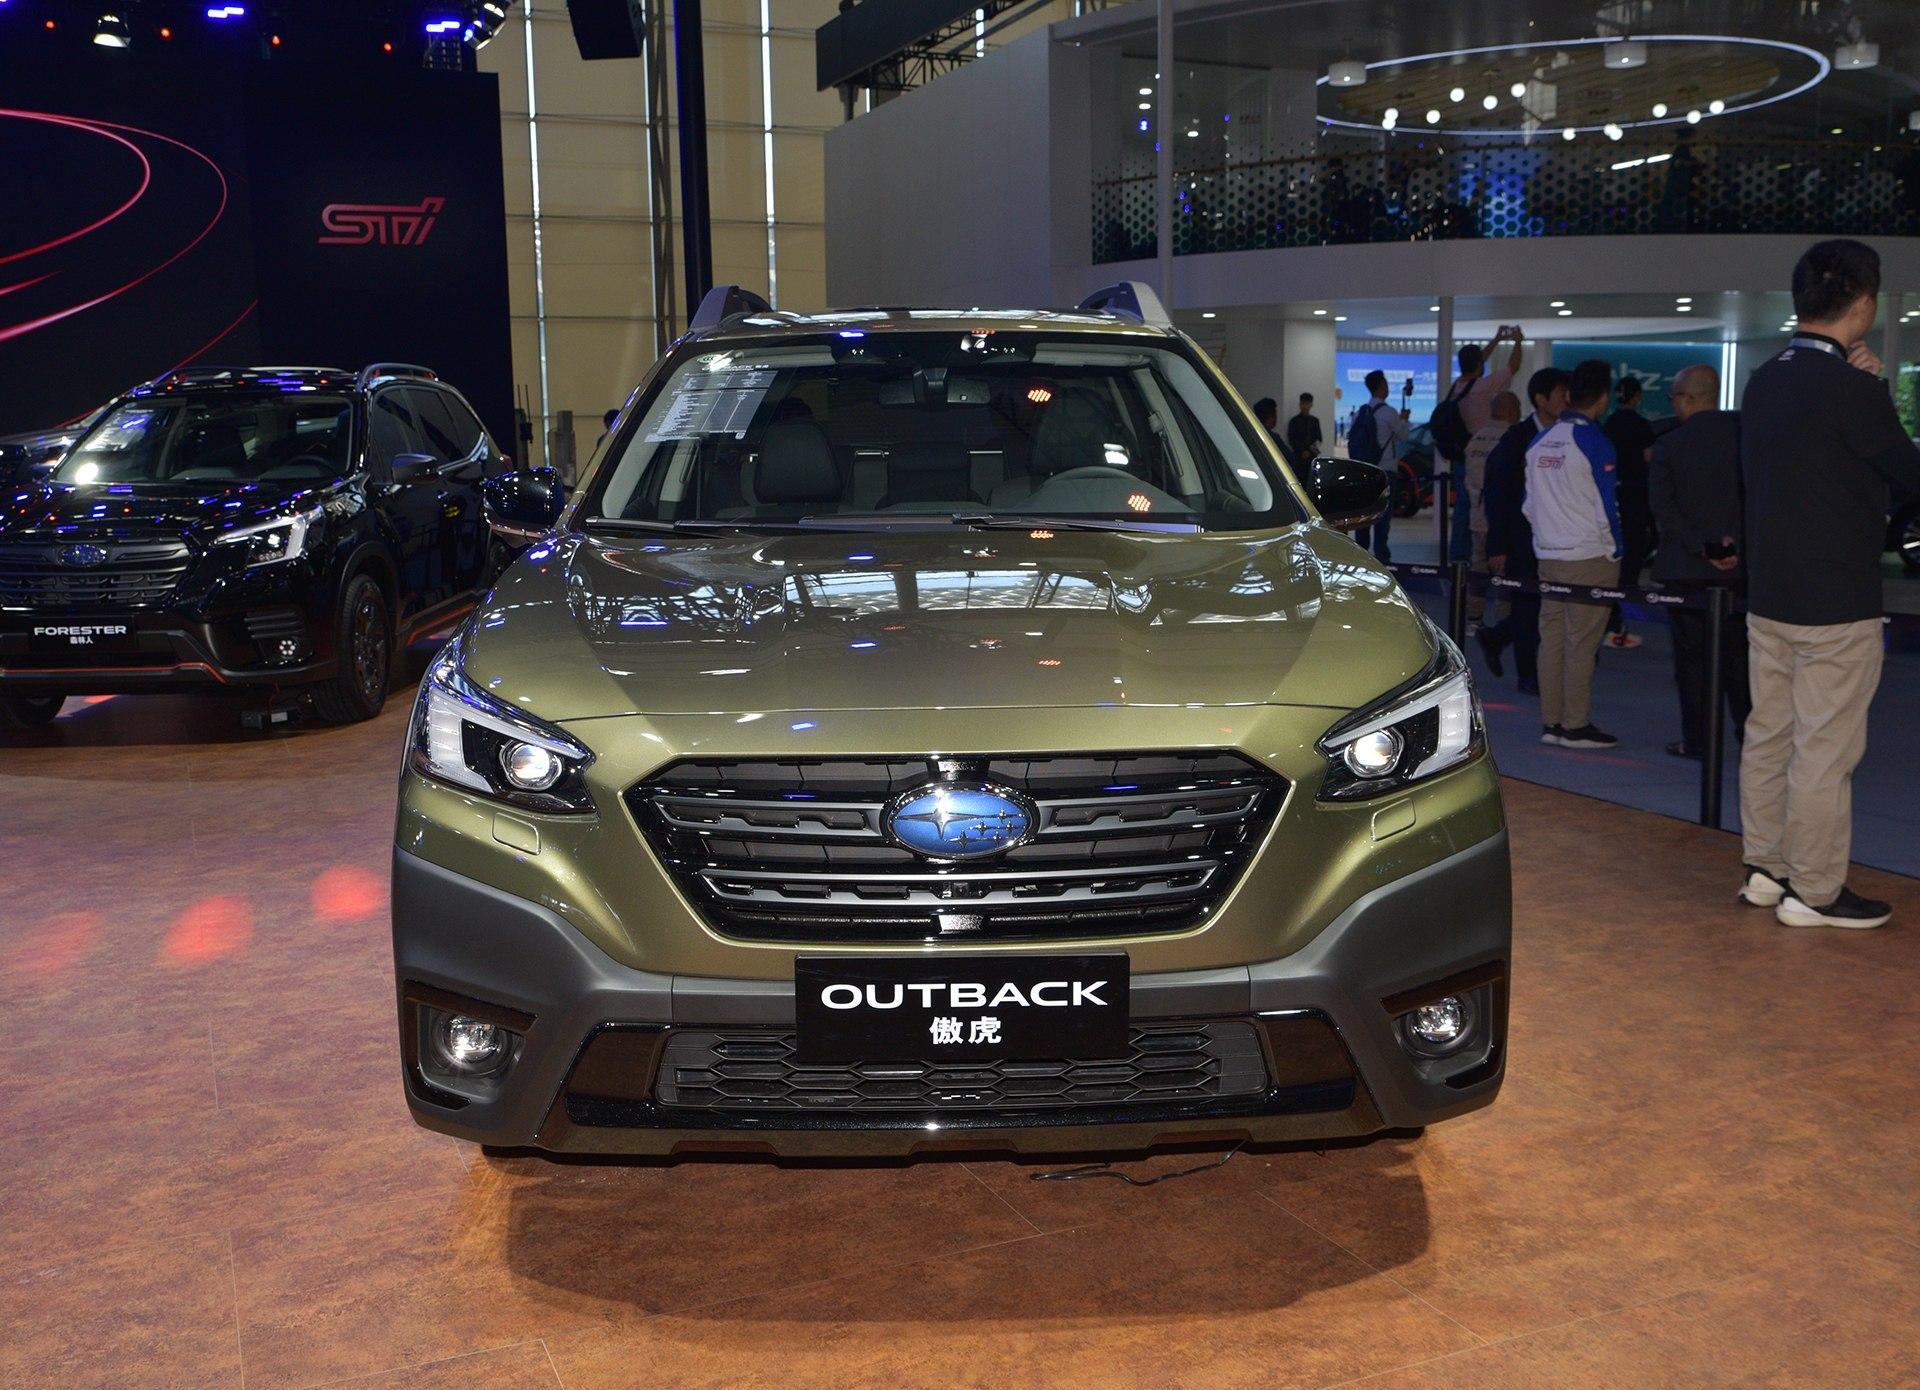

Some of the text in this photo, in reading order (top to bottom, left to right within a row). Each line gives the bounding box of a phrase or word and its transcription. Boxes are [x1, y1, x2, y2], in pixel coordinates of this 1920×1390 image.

[34, 625, 127, 635] FORESTER
[820, 980, 1108, 1010] OUTBACK
[929, 1015, 1002, 1045] 傲虎
